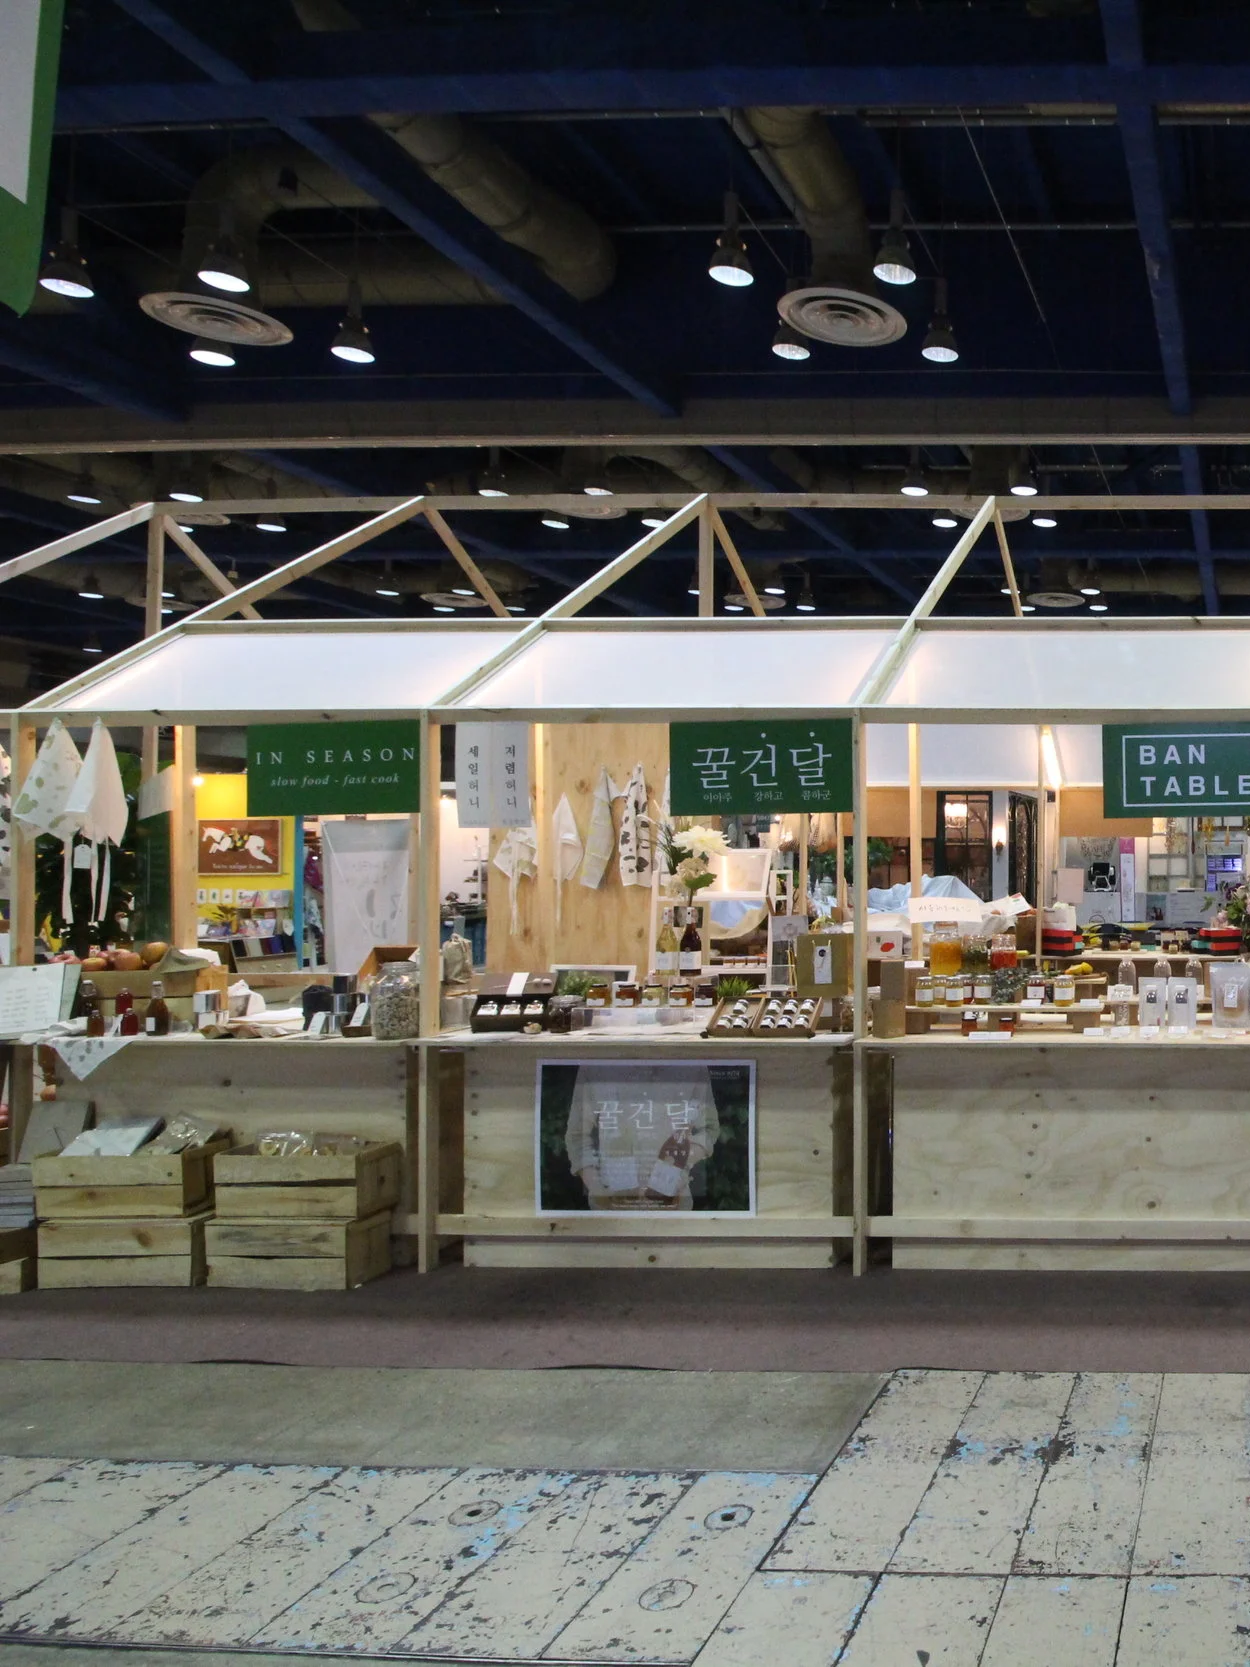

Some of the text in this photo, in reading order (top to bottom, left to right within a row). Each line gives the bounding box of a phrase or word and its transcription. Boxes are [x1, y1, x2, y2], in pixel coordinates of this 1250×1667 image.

[255, 747, 415, 765] IN SEASON
[692, 732, 833, 789] 꿀건달
[1138, 743, 1207, 766] BAN
[270, 775, 298, 787] slow
[301, 775, 331, 789] food
[342, 774, 367, 788] fast
[371, 773, 400, 784] cook
[754, 790, 784, 802] 강하고
[593, 1092, 695, 1131] 꿀건달
